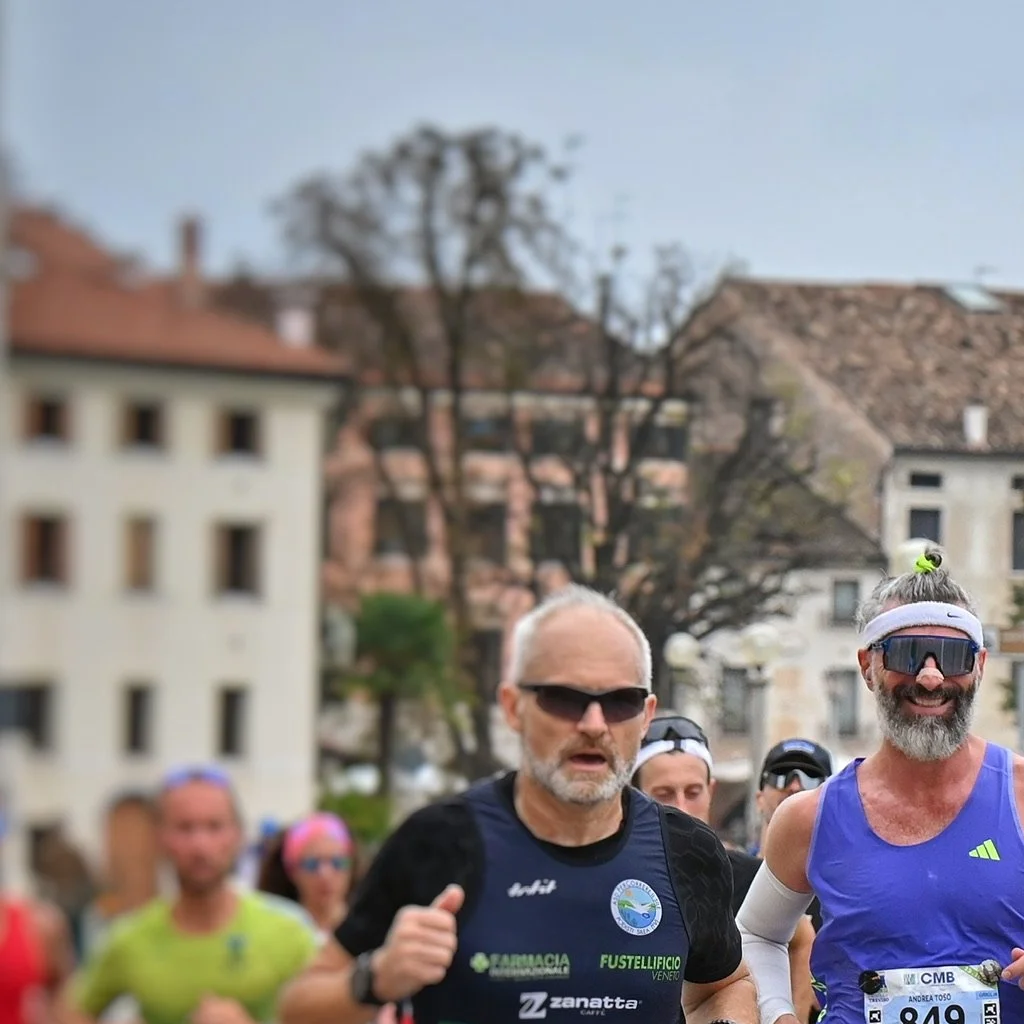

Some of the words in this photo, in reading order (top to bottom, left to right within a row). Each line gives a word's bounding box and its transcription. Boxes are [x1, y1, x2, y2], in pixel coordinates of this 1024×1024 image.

[489, 953, 571, 968] FARMACIA
[599, 954, 681, 970] FUSTELLIFICIO
[652, 971, 680, 981] VENETO
[921, 972, 955, 984] CMB
[549, 996, 639, 1010] zanatta
[909, 994, 934, 1003] ANDREA
[934, 993, 952, 1002] TOSO
